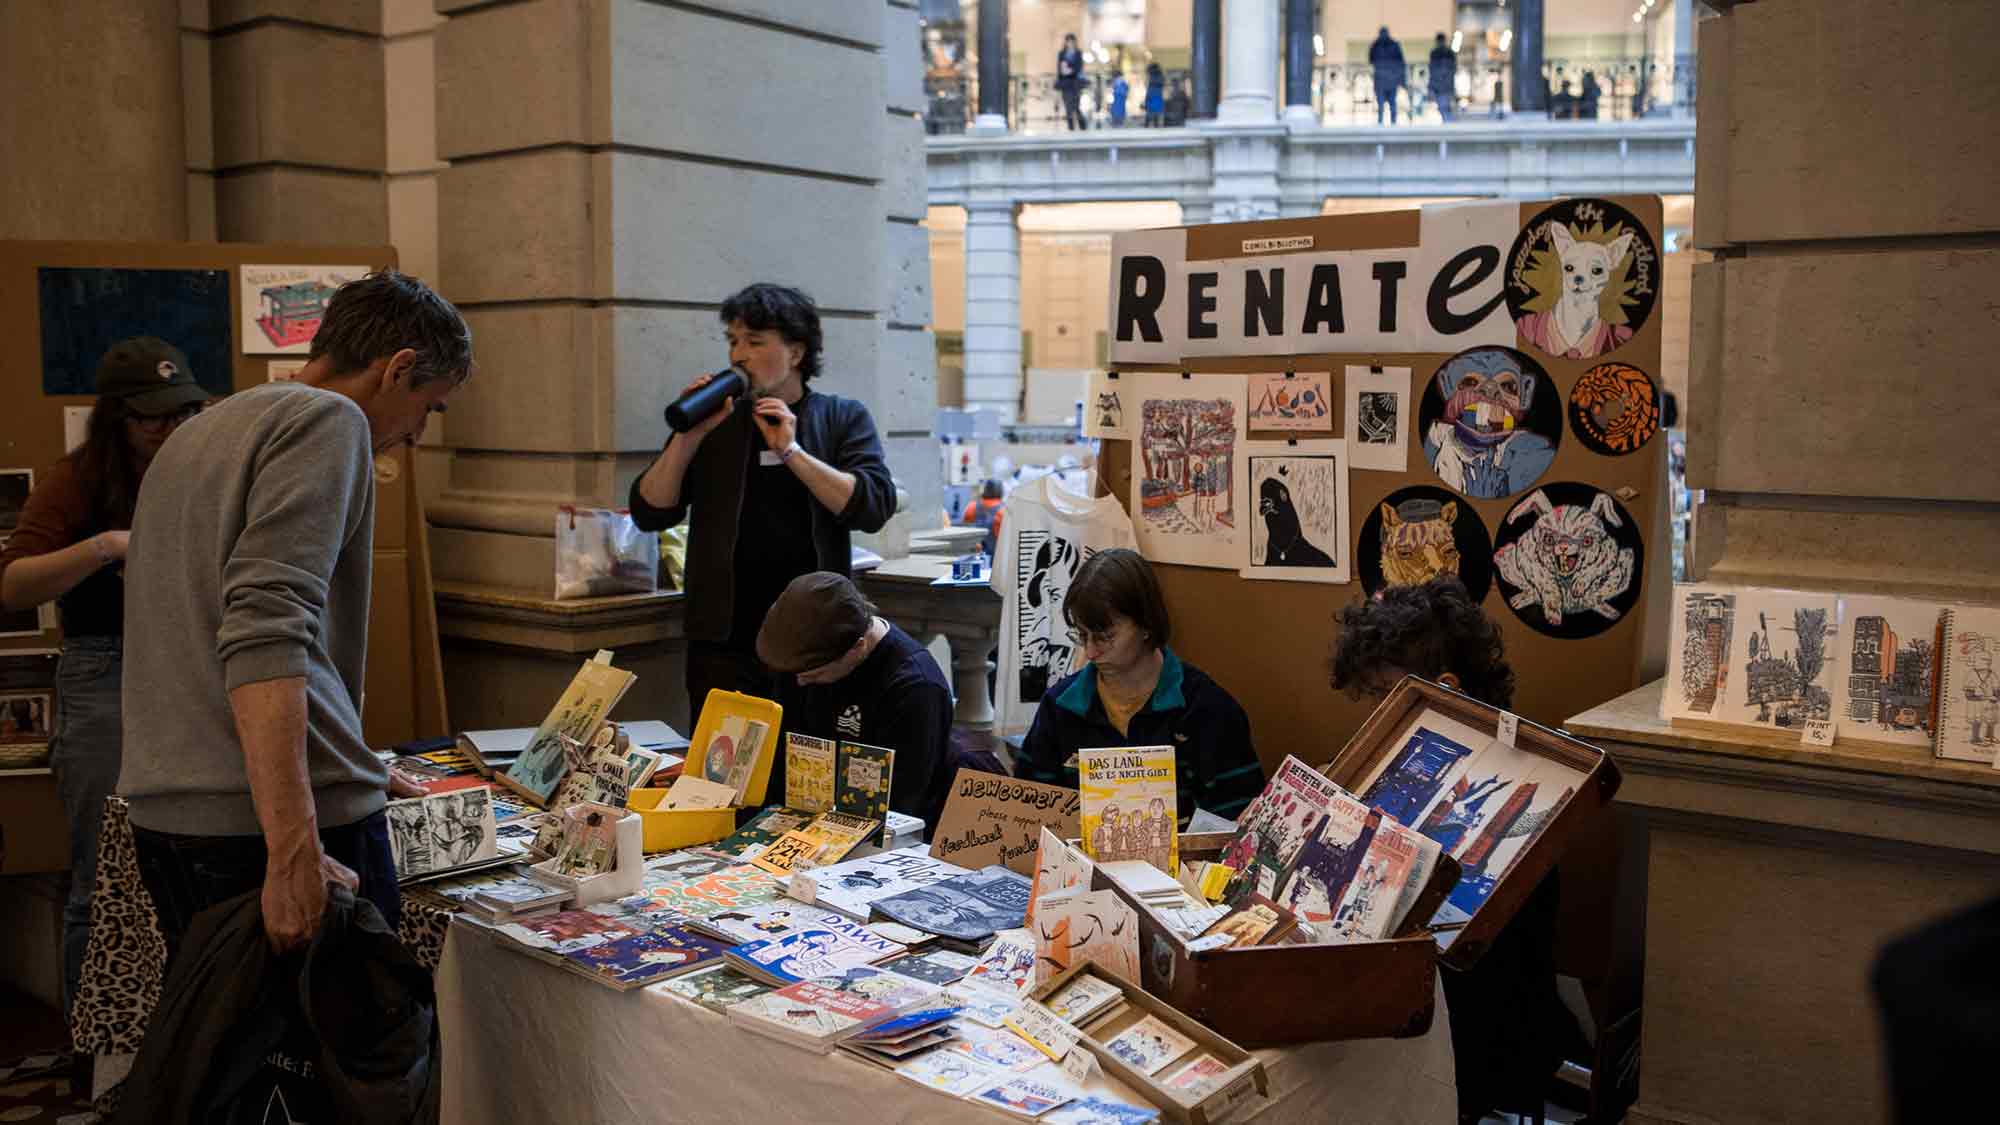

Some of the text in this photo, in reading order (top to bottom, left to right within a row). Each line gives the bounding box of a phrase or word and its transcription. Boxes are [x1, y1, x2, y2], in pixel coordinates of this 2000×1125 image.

[1575, 203, 1604, 221] the
[1088, 755, 1144, 771] DAS LAND
[1089, 770, 1104, 780] DAS
[940, 823, 1003, 857] feedback
[820, 915, 895, 950] DAWN
